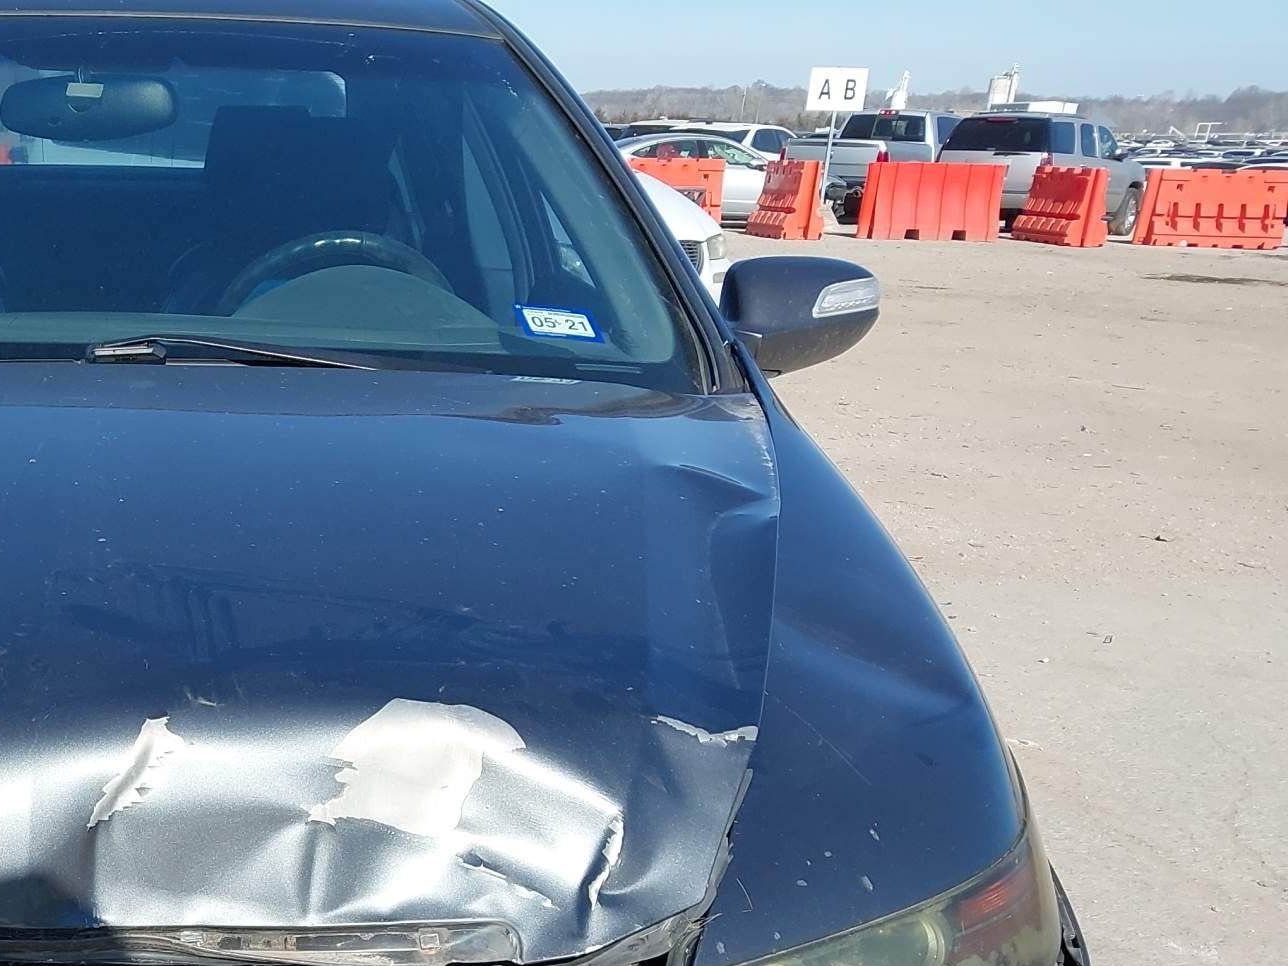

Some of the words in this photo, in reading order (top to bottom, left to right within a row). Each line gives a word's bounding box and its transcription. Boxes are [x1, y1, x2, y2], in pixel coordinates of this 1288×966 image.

[818, 78, 831, 100] A
[844, 78, 857, 100] B
[531, 316, 556, 329] 05
[565, 318, 588, 332] 21
